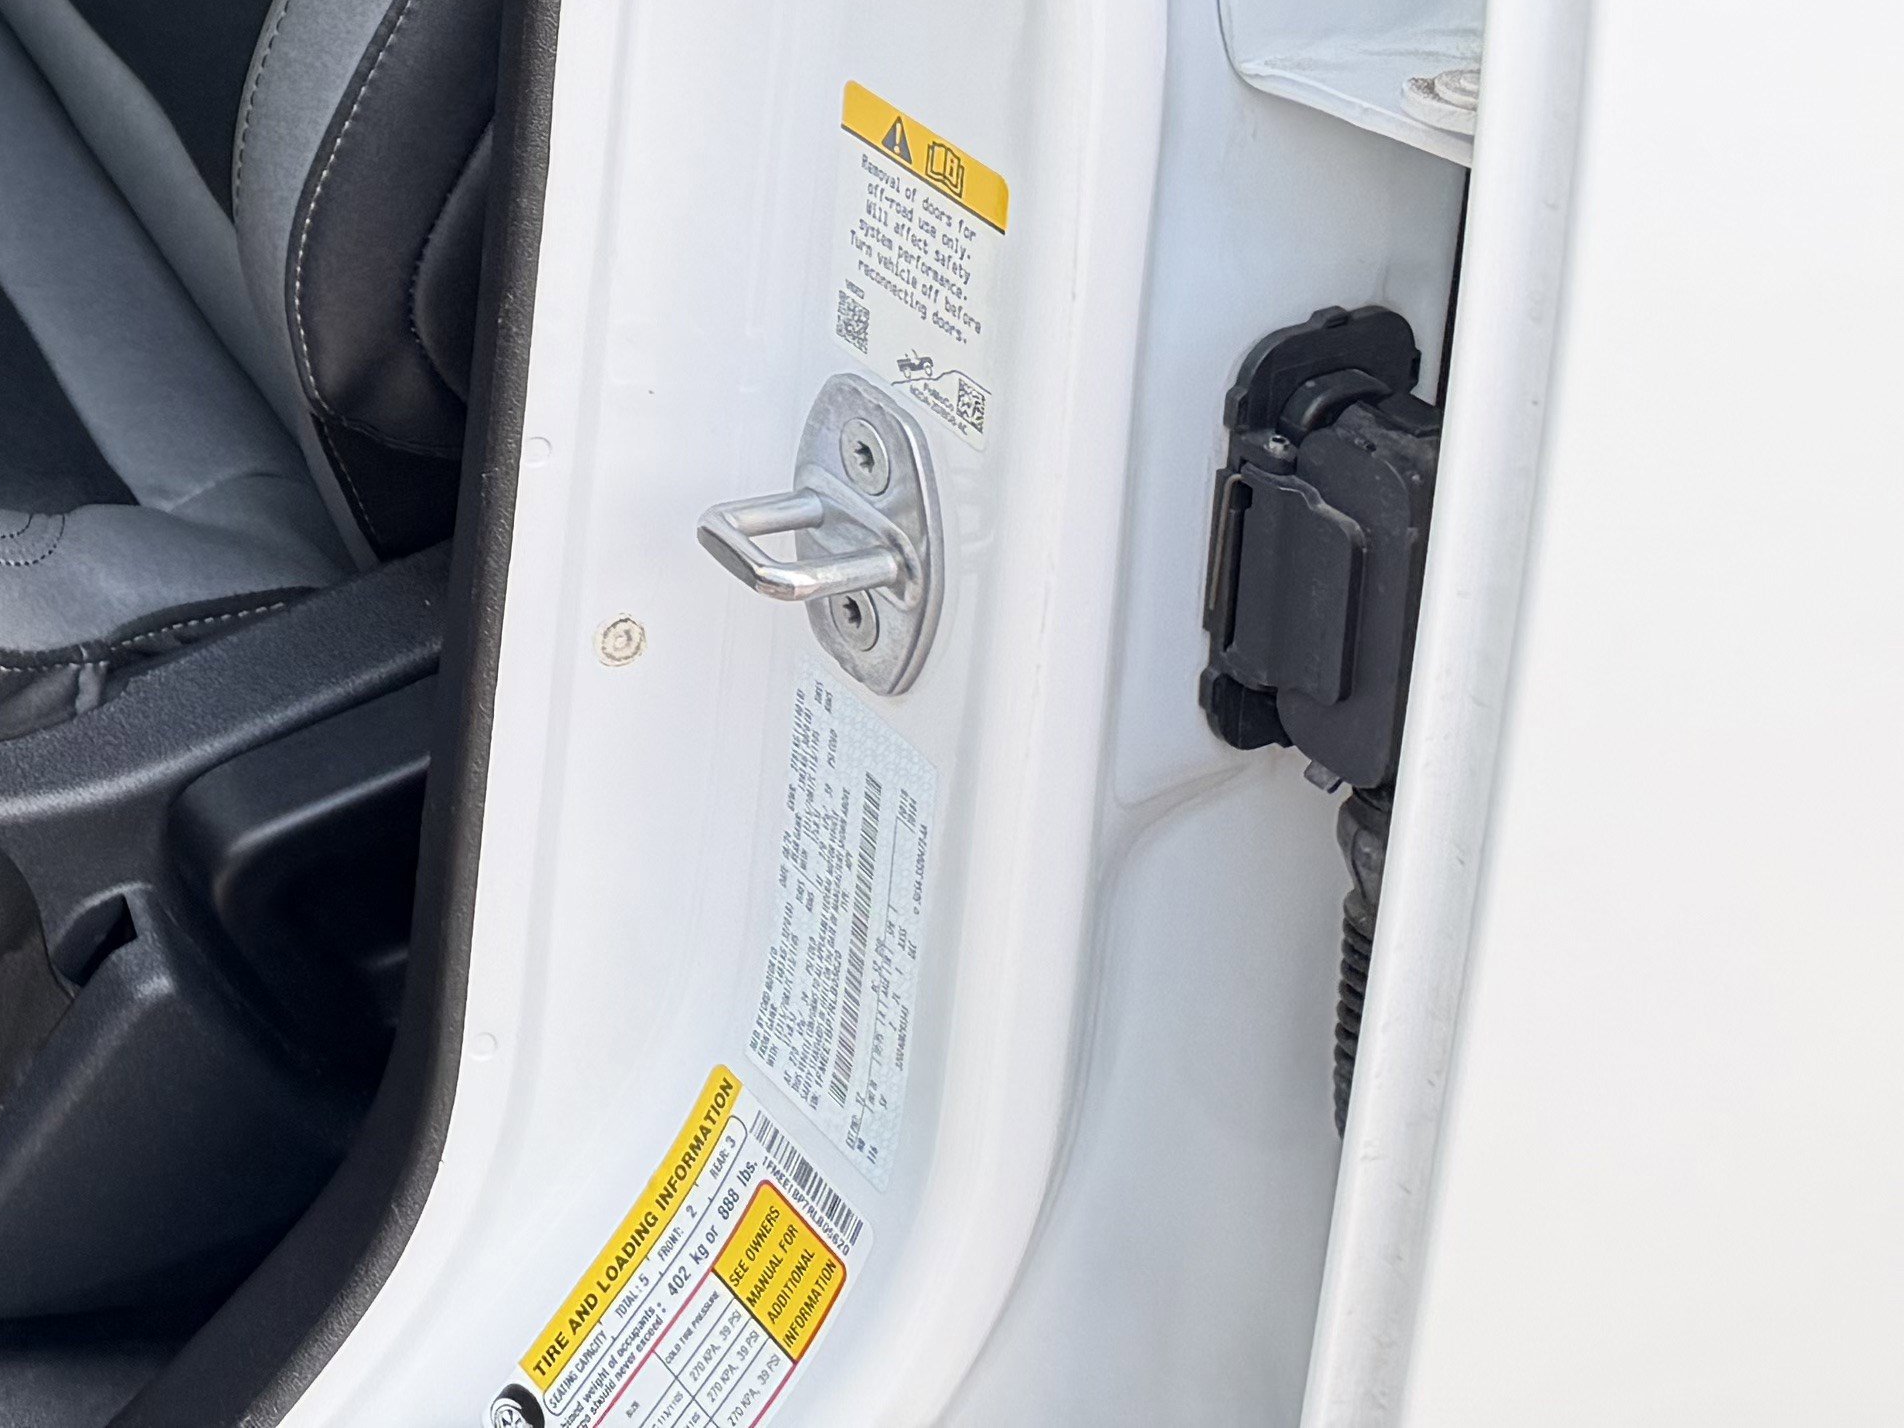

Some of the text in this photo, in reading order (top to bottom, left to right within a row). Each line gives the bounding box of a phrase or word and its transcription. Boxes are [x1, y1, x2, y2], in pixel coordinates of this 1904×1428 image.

[861, 153, 977, 242] Removal of doors for
[867, 182, 971, 261] off-road use only.
[850, 229, 873, 258] Turn
[877, 252, 918, 290] vehicle
[921, 283, 940, 304] off
[944, 295, 982, 335] before
[859, 218, 893, 251] system
[897, 245, 968, 301] performance.
[866, 199, 971, 286] Will affect safety
[858, 259, 927, 321] reconnecting
[932, 310, 968, 345] doors.
[533, 1078, 733, 1376] TIRE AND LOADING INFORMATION
[667, 1161, 758, 1296] 402 kg or 888 lbs.
[729, 1205, 780, 1287] SEE OWNERS
[746, 1224, 799, 1307] MANUAL FOR
[549, 1370, 578, 1409] SEATING
[575, 1330, 607, 1373] CAPACITY
[638, 1273, 650, 1287] 5
[657, 1227, 684, 1262] FRONT:
[685, 1204, 698, 1219] 2
[709, 1149, 730, 1180] REAR:
[725, 1135, 736, 1149] 3
[767, 1249, 815, 1324] ADDITIONAL
[783, 1259, 836, 1348] INFORMATION
[583, 1367, 610, 1403] weight
[607, 1354, 619, 1369] of
[617, 1306, 655, 1357] occupants
[590, 1314, 664, 1415] should never exceed
[665, 1343, 682, 1365] COLD
[689, 1361, 706, 1382] 270
[719, 1325, 732, 1341] 39
[727, 1309, 742, 1328] PSI
[706, 1381, 723, 1403] 270
[736, 1345, 749, 1362] 39
[745, 1329, 760, 1348] PSI
[727, 1406, 744, 1428] 270
[757, 1369, 770, 1386] 39
[766, 1353, 781, 1372] PSI
